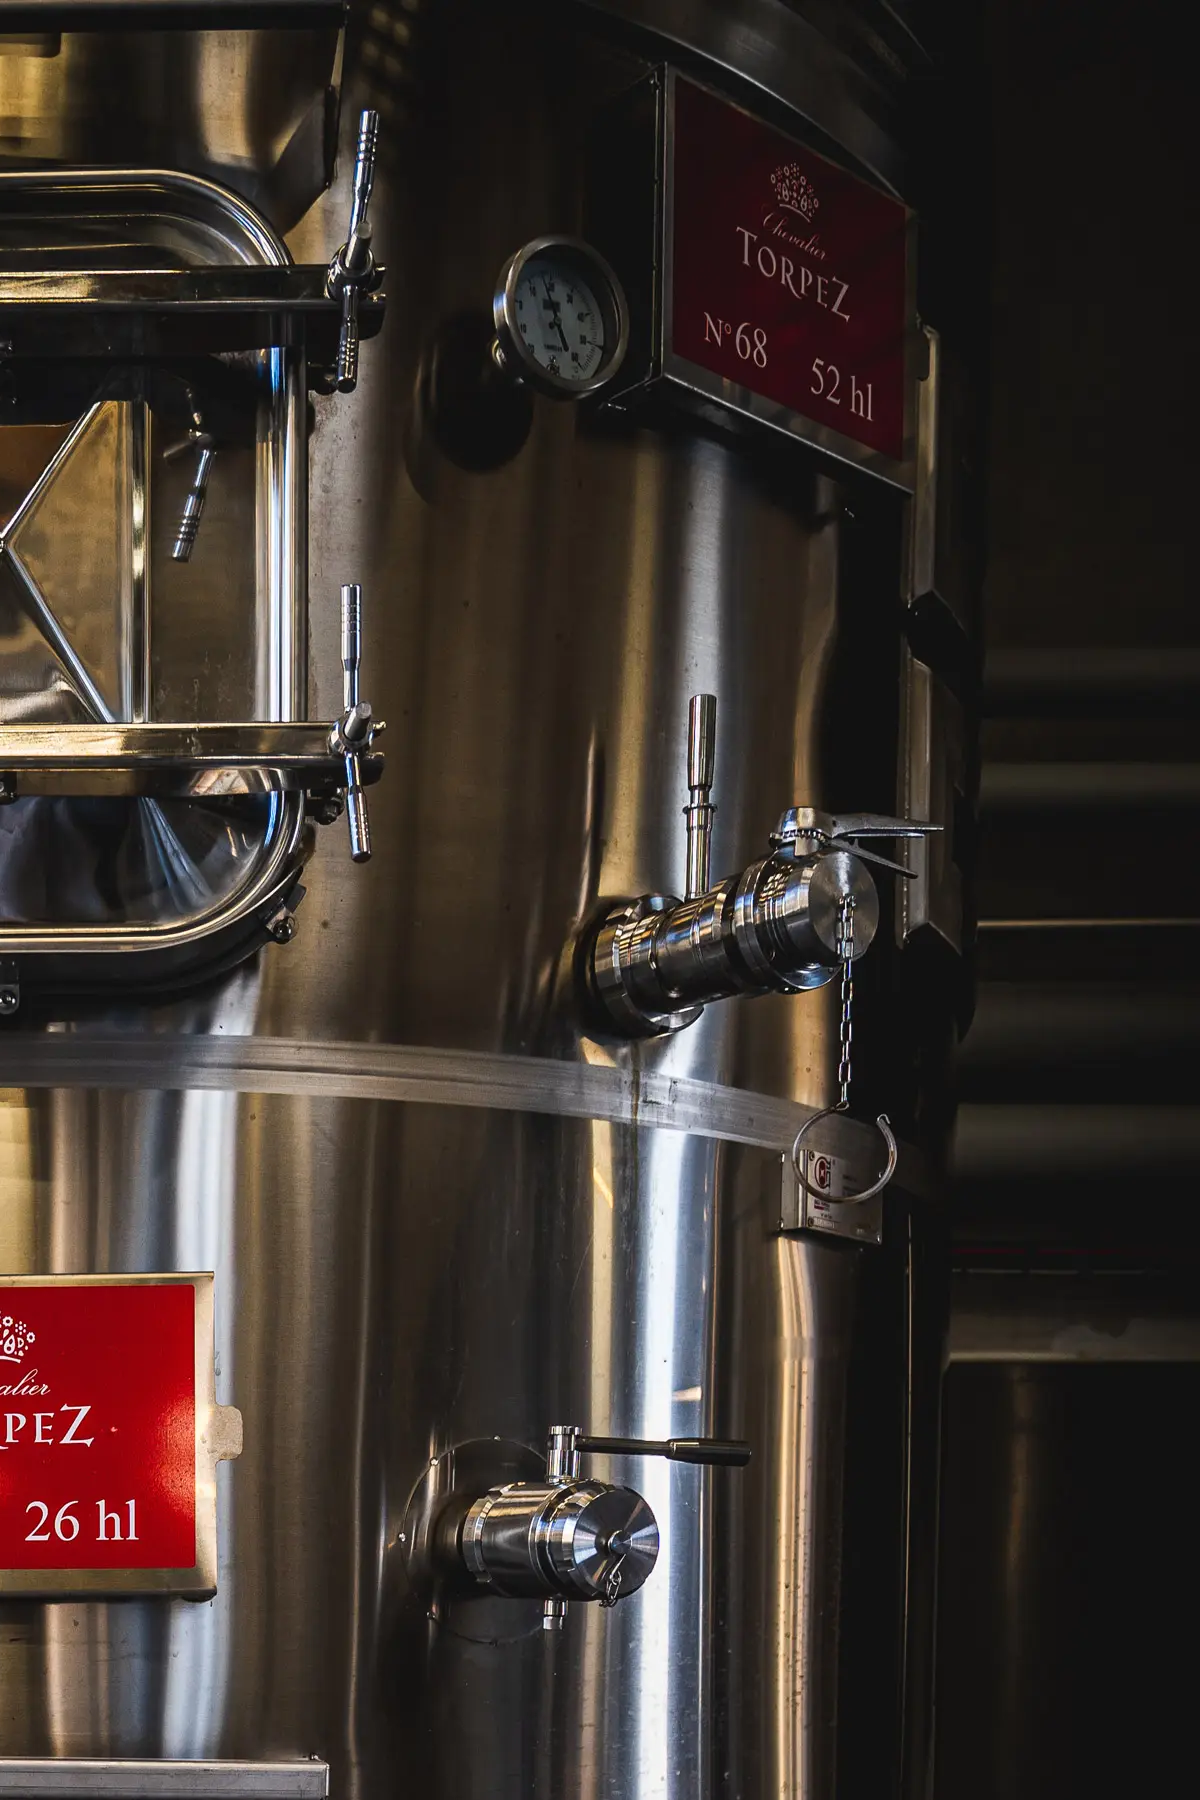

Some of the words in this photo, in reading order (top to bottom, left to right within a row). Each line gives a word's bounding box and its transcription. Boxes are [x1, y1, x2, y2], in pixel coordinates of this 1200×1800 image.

[762, 206, 826, 260] Chevalier
[736, 226, 850, 323] TORPEZ
[810, 357, 841, 405] 52
[850, 375, 874, 422] hl
[24, 1500, 81, 1542] 26
[95, 1499, 140, 1542] hl
